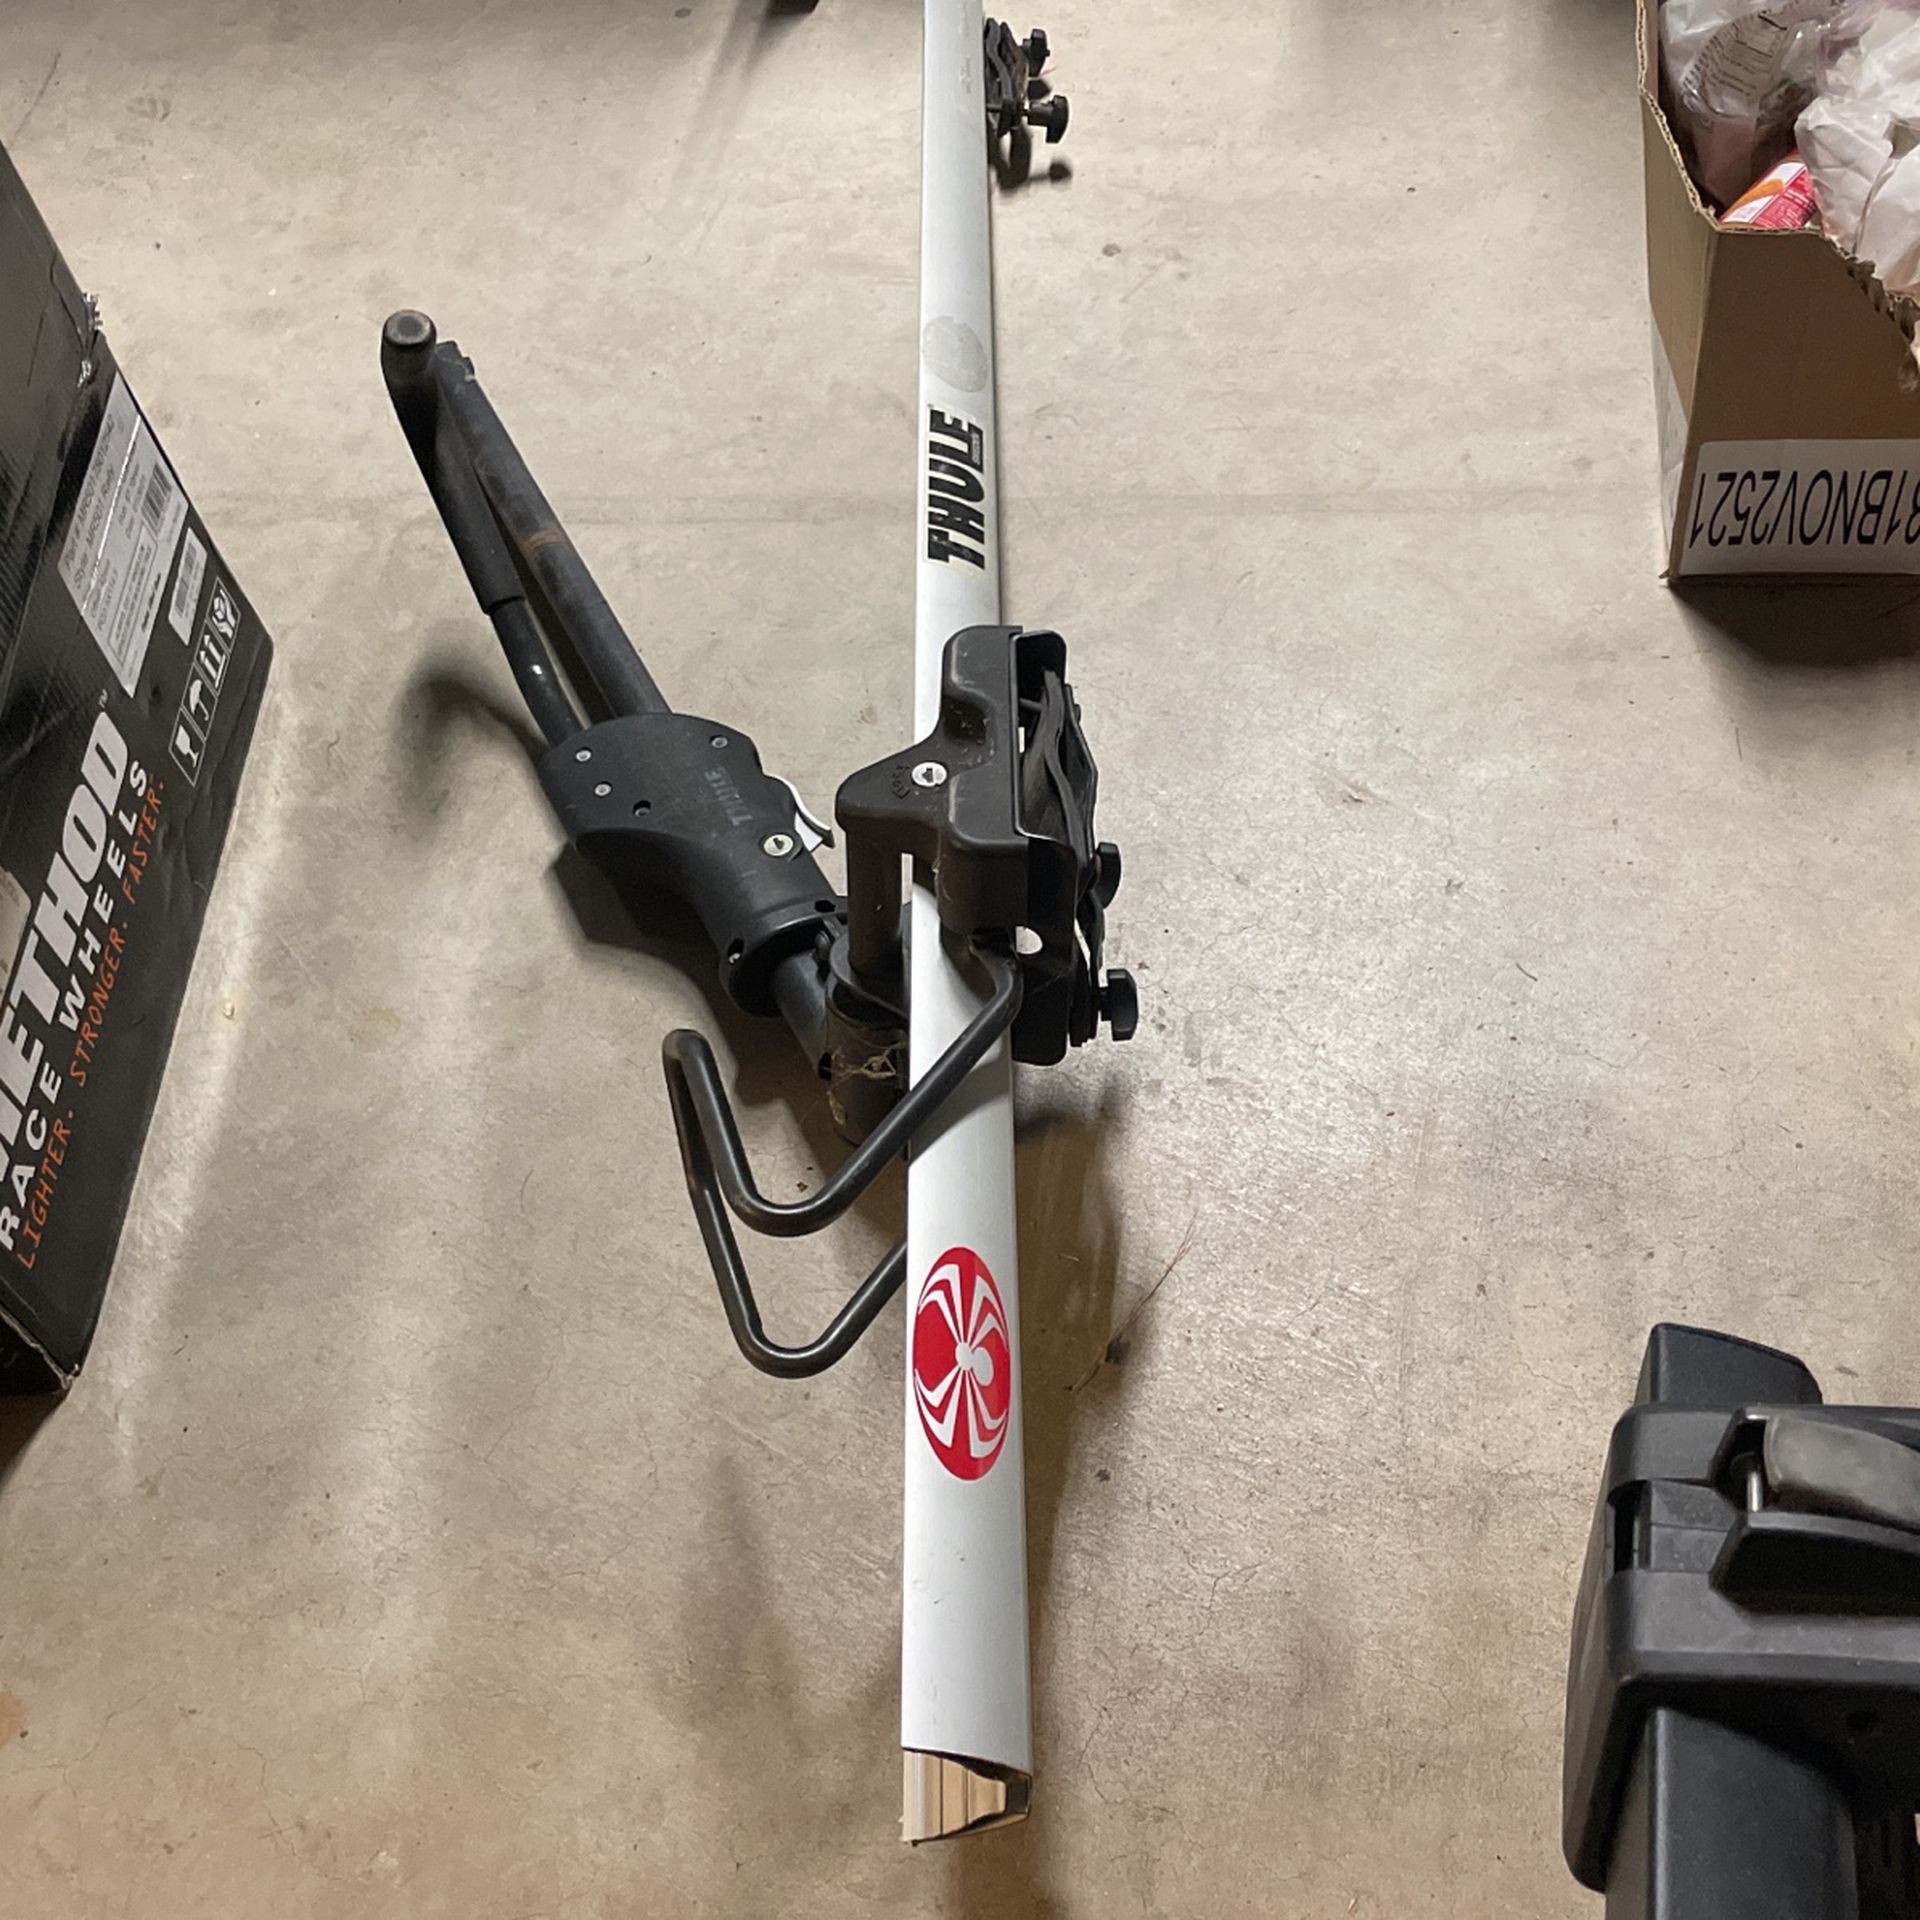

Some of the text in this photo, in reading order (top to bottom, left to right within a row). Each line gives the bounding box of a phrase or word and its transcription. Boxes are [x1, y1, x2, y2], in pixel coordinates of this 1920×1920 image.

[927, 408, 985, 571] THULE
[0, 760, 147, 1251] RACE WHEELS
[17, 780, 165, 1270] LIGHTER. STRONGER. FASTER.
